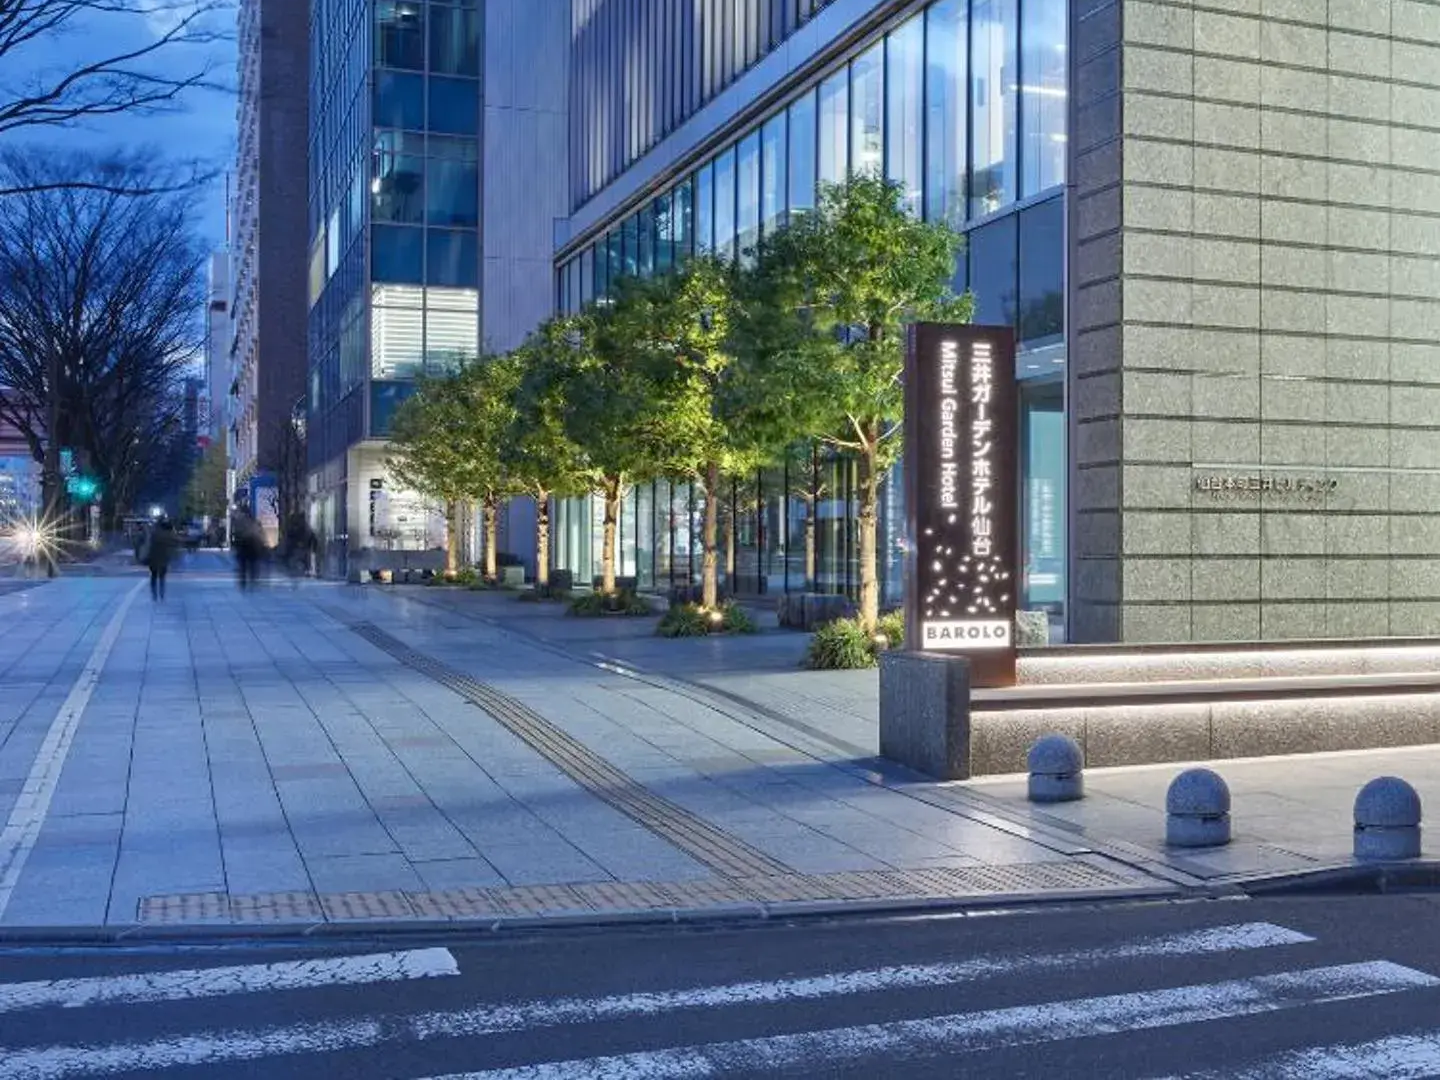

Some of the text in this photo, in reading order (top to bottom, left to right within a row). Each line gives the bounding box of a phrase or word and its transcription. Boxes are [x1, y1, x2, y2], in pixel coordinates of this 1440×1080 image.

[940, 341, 957, 507] Mitsui Garden Hotel
[972, 342, 992, 554] 三井ガーデンホテル仙台
[926, 626, 1006, 639] BAROLO
